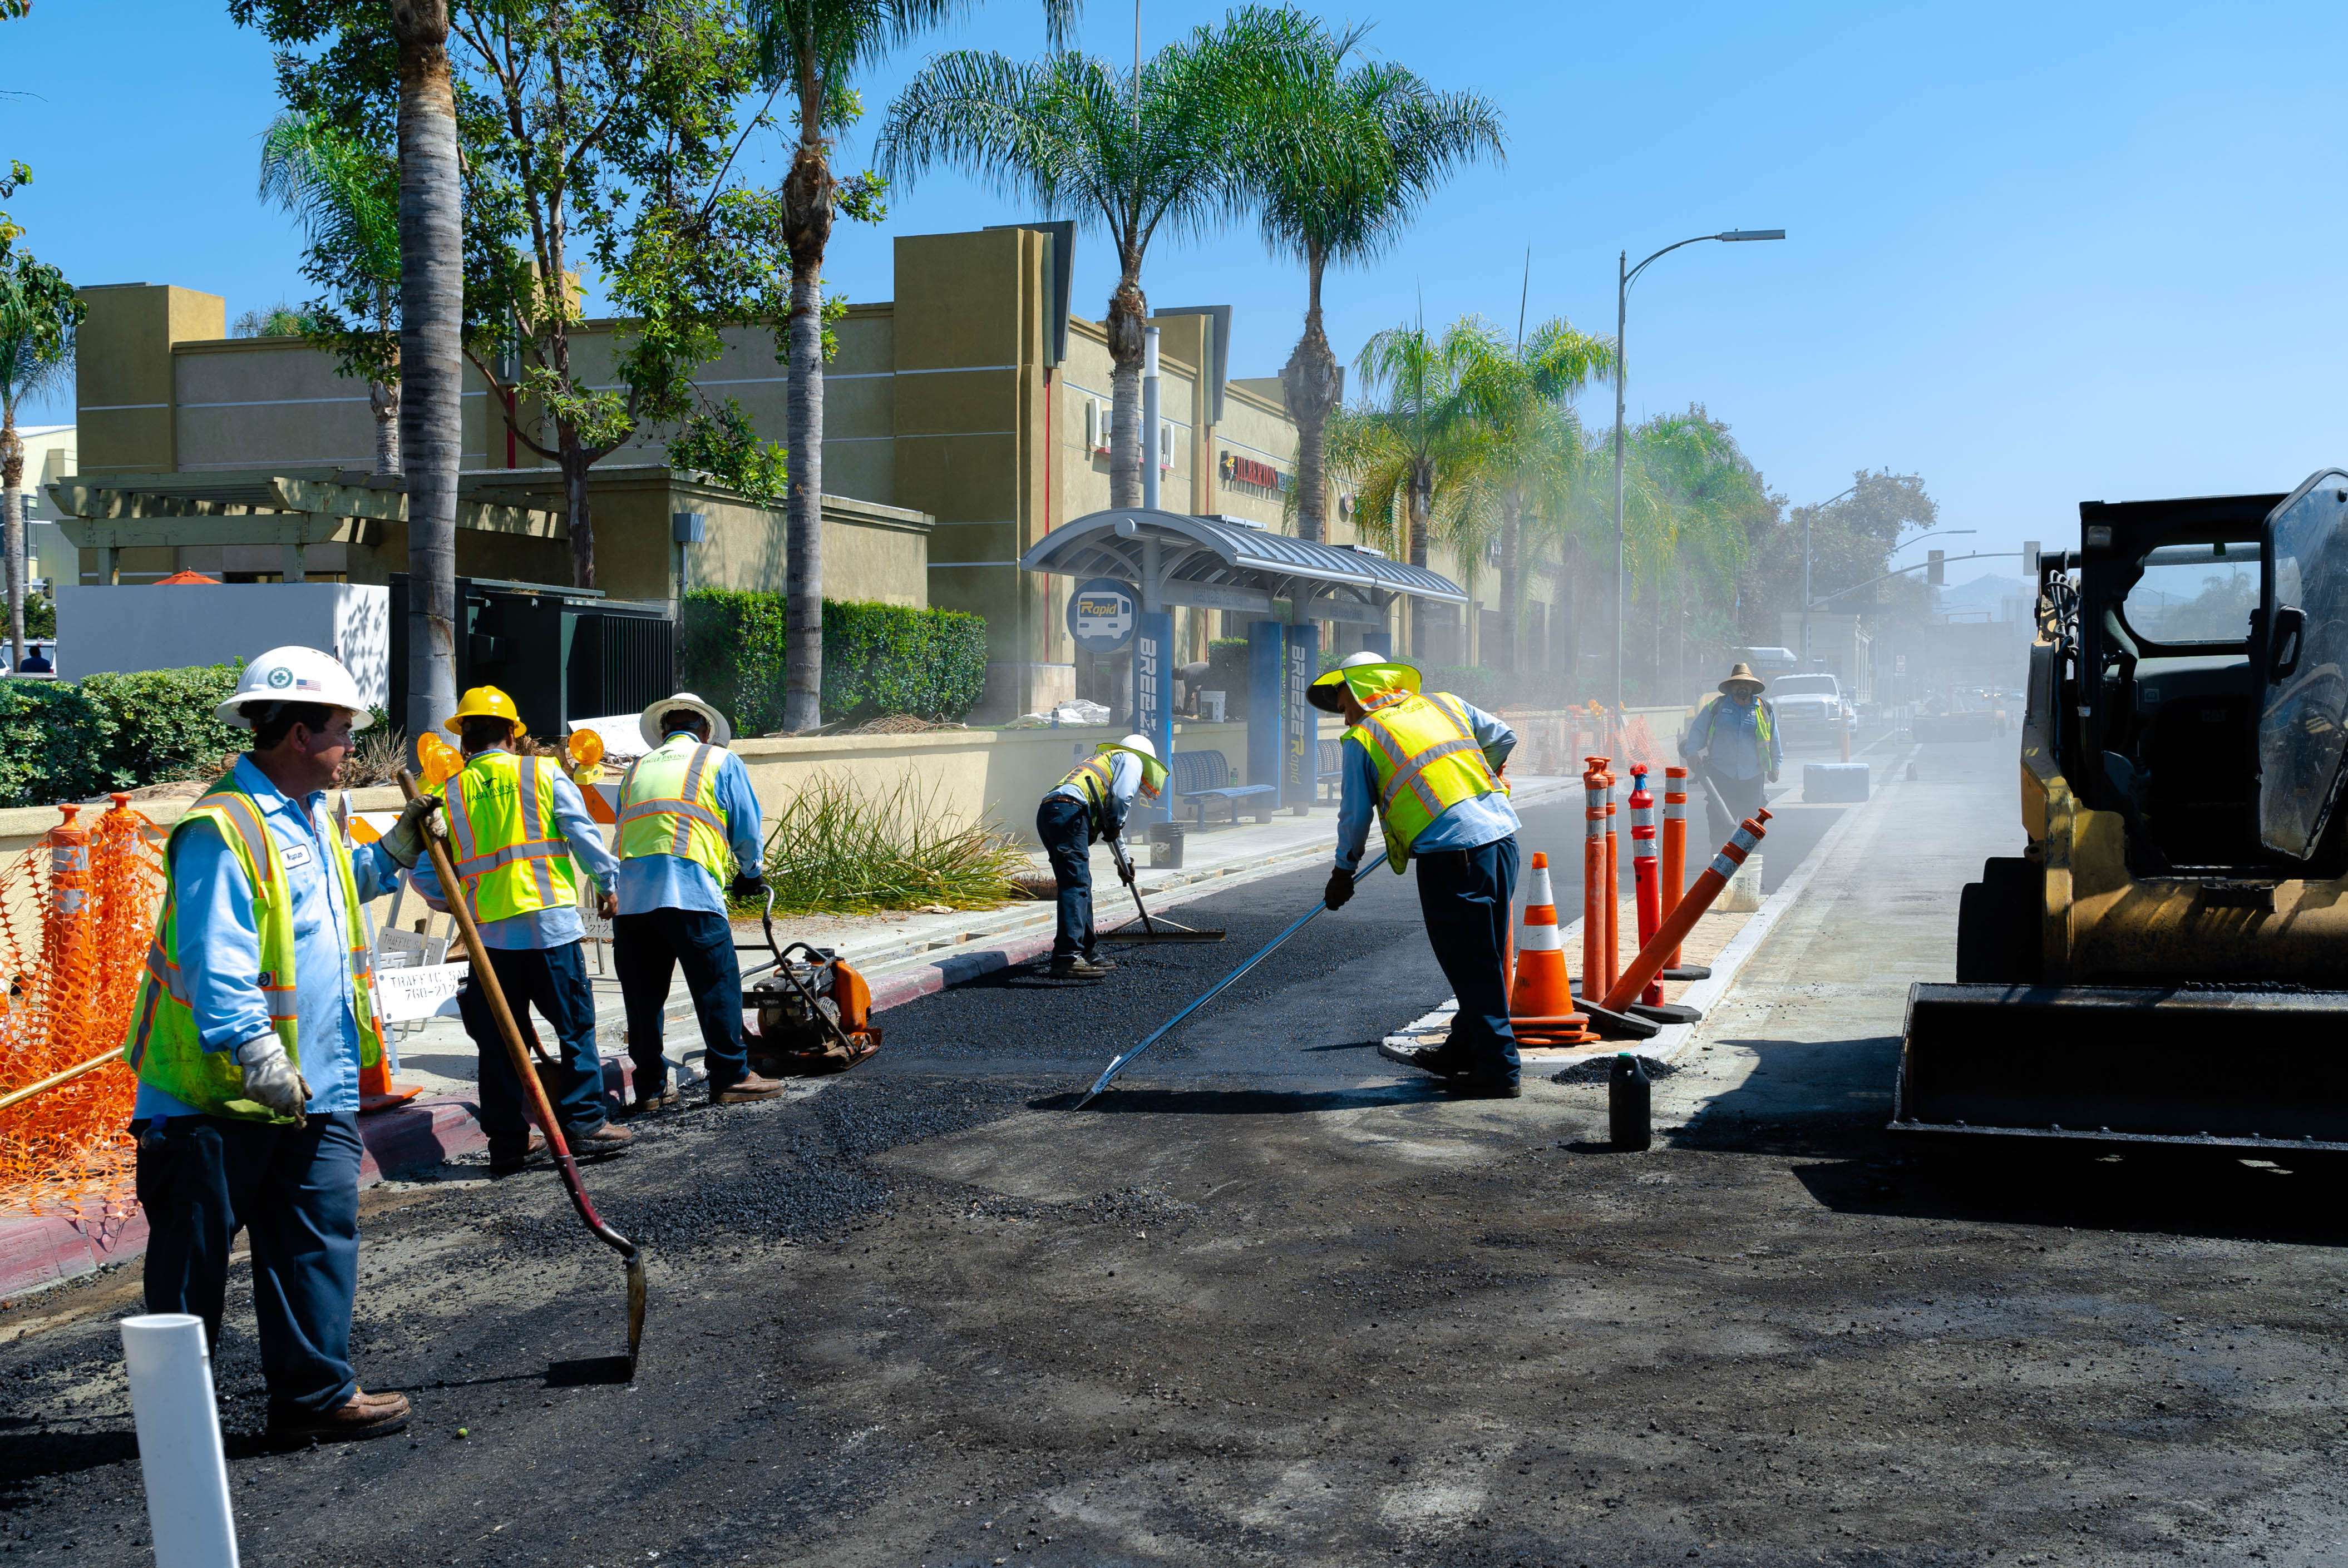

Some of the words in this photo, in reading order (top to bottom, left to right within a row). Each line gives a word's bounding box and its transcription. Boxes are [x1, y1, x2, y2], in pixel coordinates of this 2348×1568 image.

[1075, 601, 1117, 617] Rapid
[1291, 645, 1305, 736] BREEZE
[1289, 733, 1304, 785] Rapid
[467, 791, 489, 802] EAGLE
[489, 782, 517, 796] PAVING
[384, 934, 412, 948] TRAFFIC
[390, 972, 443, 988] TRAFFIC
